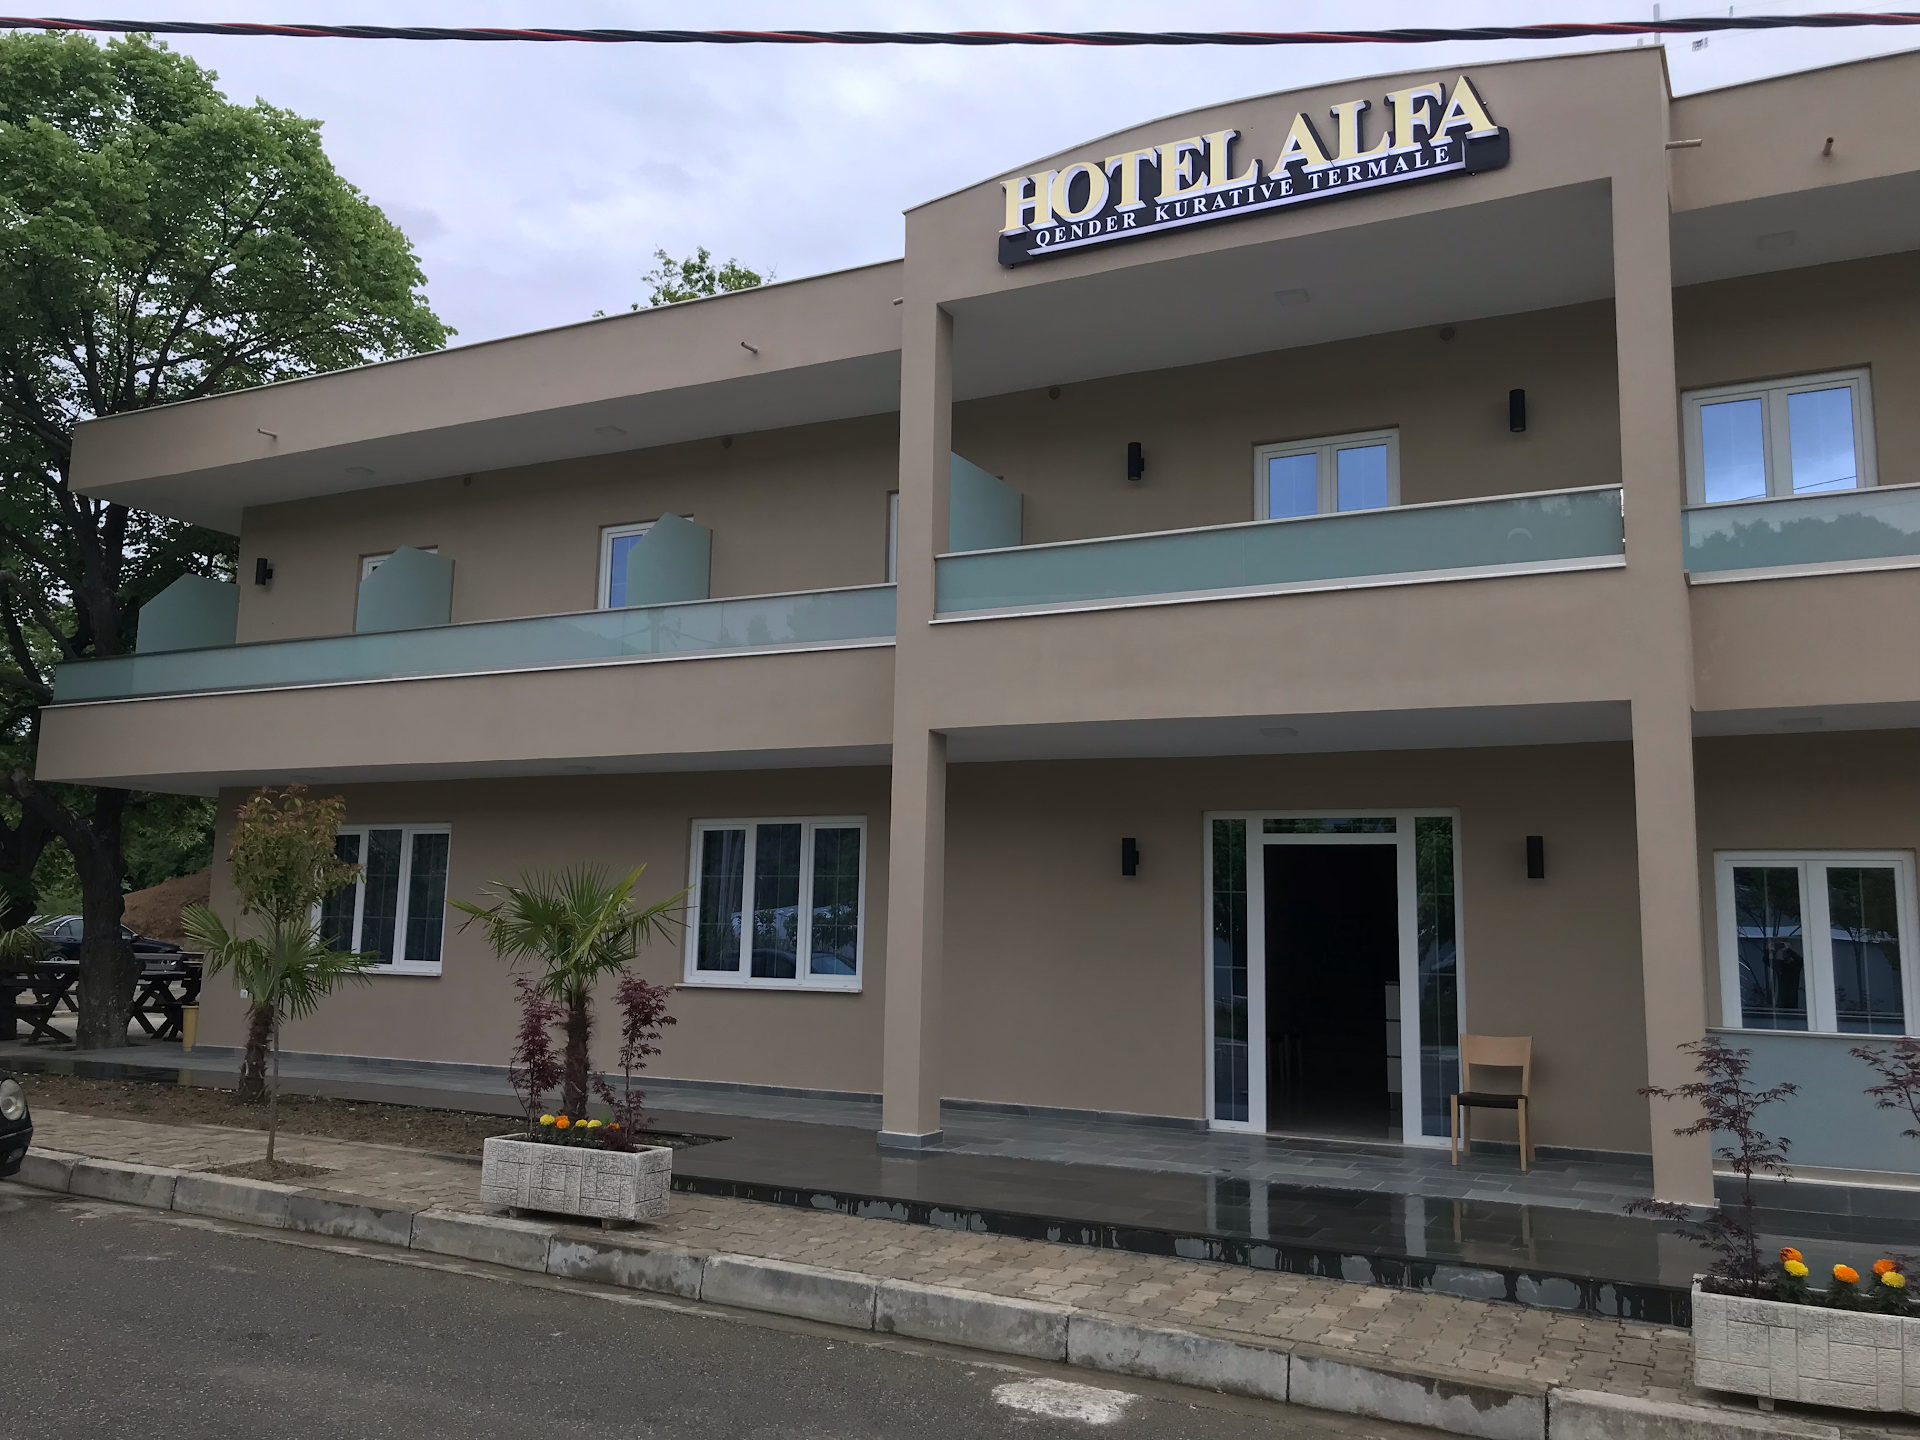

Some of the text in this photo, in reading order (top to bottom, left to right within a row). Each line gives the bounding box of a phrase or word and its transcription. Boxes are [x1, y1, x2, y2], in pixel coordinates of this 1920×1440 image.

[999, 75, 1499, 235] HOTEL ALFA
[1035, 146, 1450, 248] QENDER KURATIVE TERMALE
